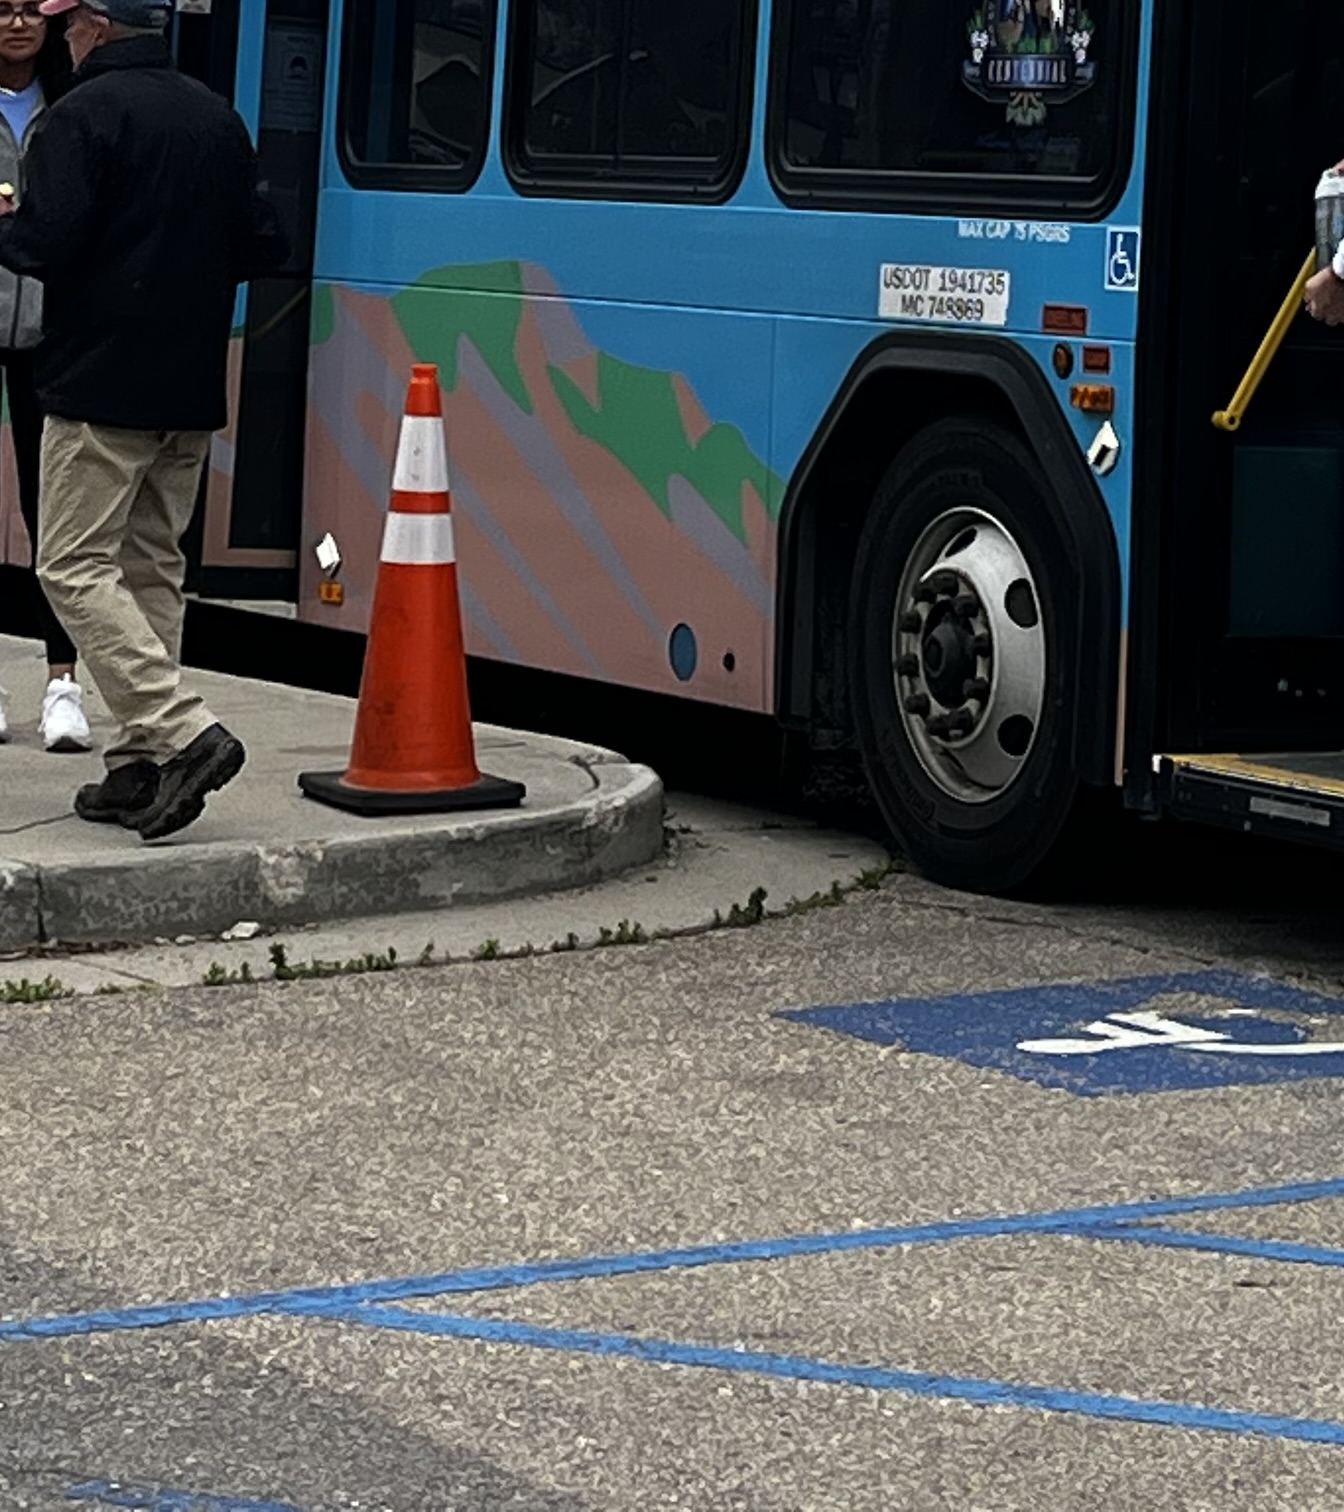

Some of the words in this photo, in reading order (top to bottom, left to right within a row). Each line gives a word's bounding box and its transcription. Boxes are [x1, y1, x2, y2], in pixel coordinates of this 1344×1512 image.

[883, 266, 931, 291] USDOT
[938, 268, 1006, 296] 1941735
[900, 294, 925, 317] MC
